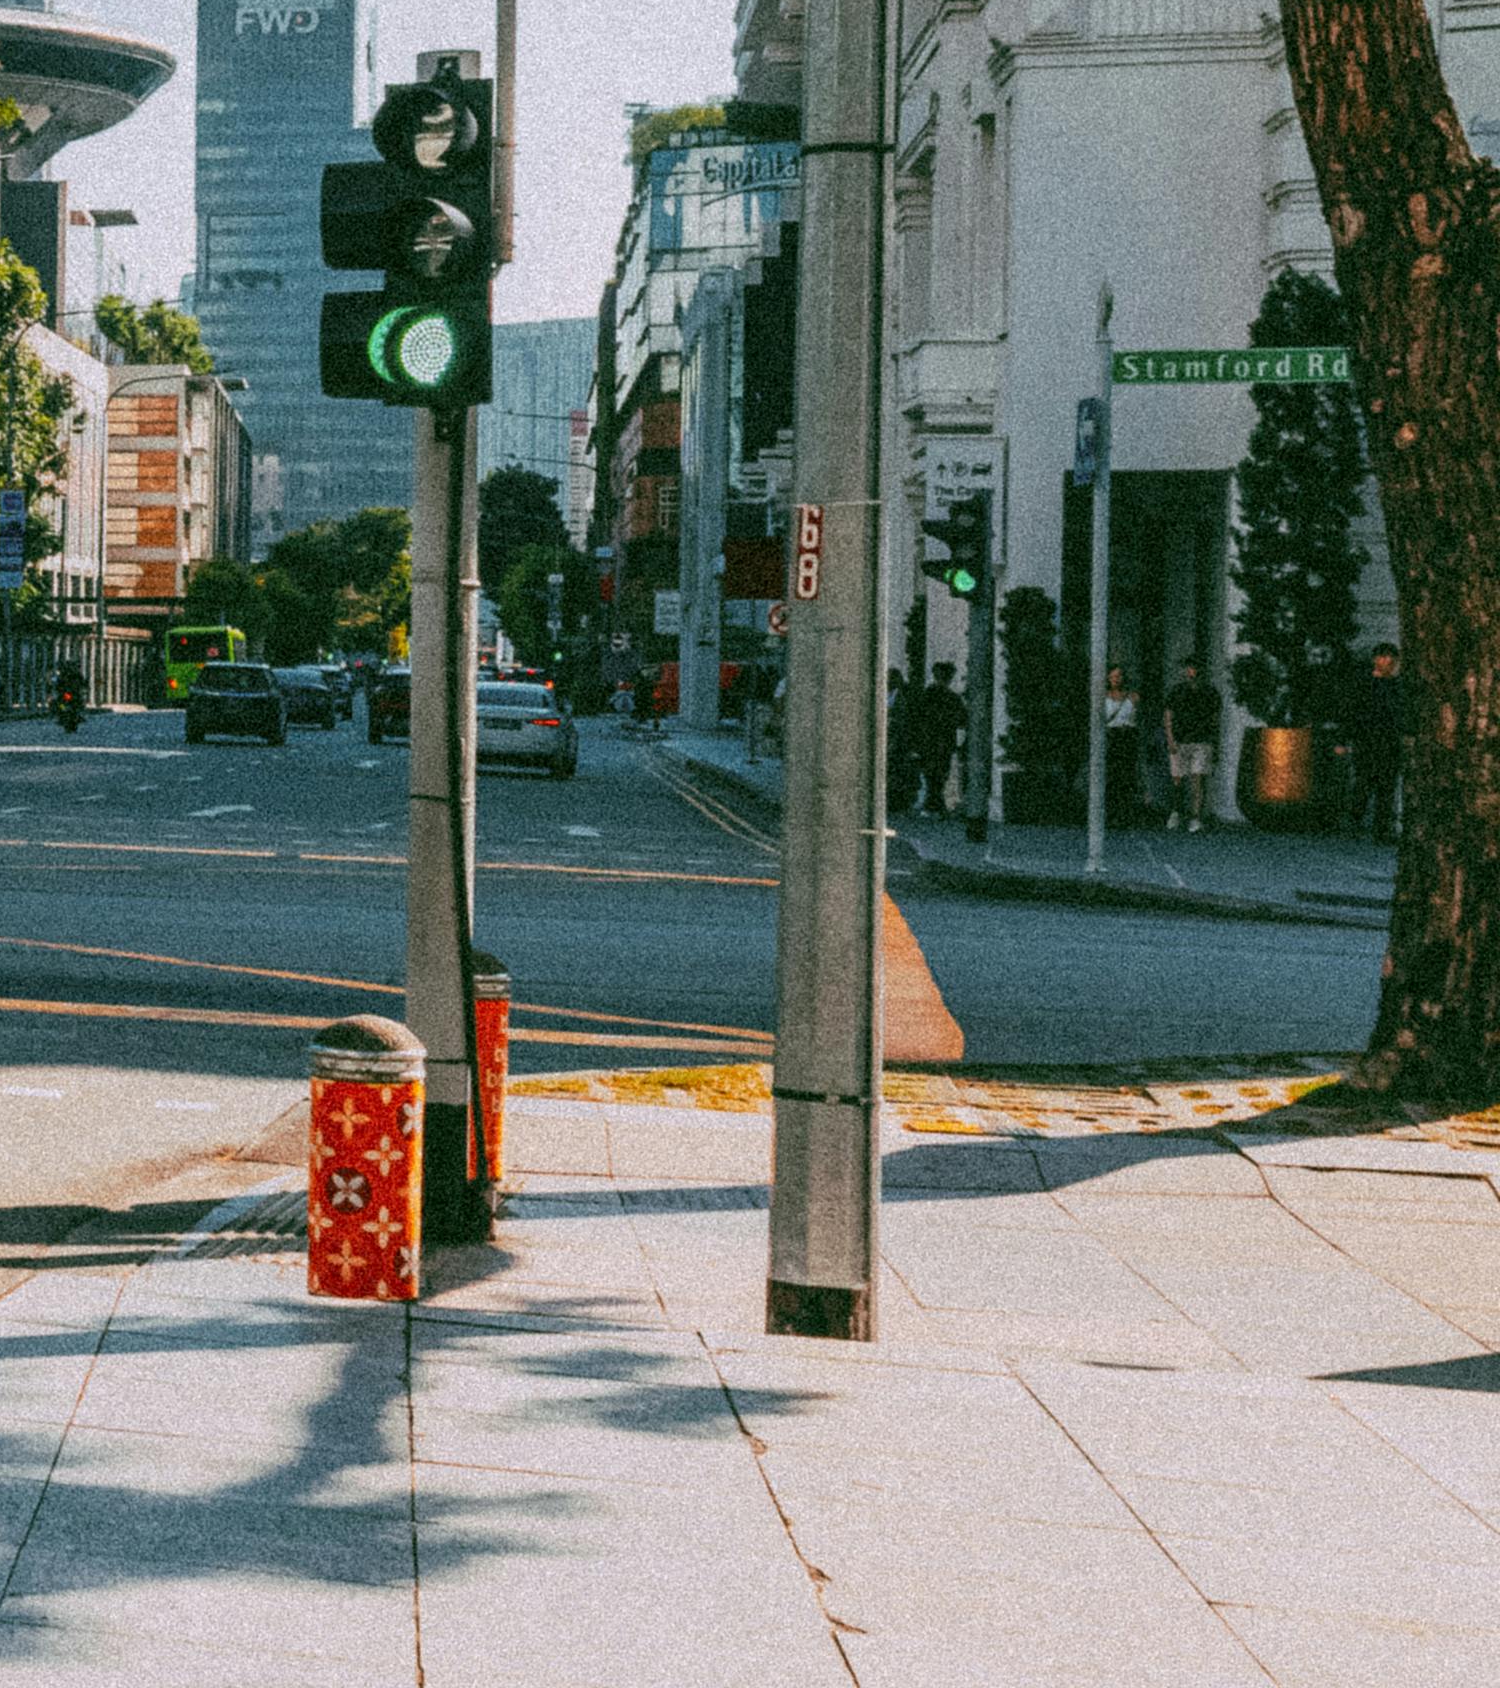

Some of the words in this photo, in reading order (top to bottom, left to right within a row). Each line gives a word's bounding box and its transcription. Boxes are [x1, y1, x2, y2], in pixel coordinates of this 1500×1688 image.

[235, 8, 320, 35] FWD
[703, 151, 799, 189] CapitaLa
[1122, 353, 1291, 379] Stamford
[1308, 353, 1349, 377] Rd
